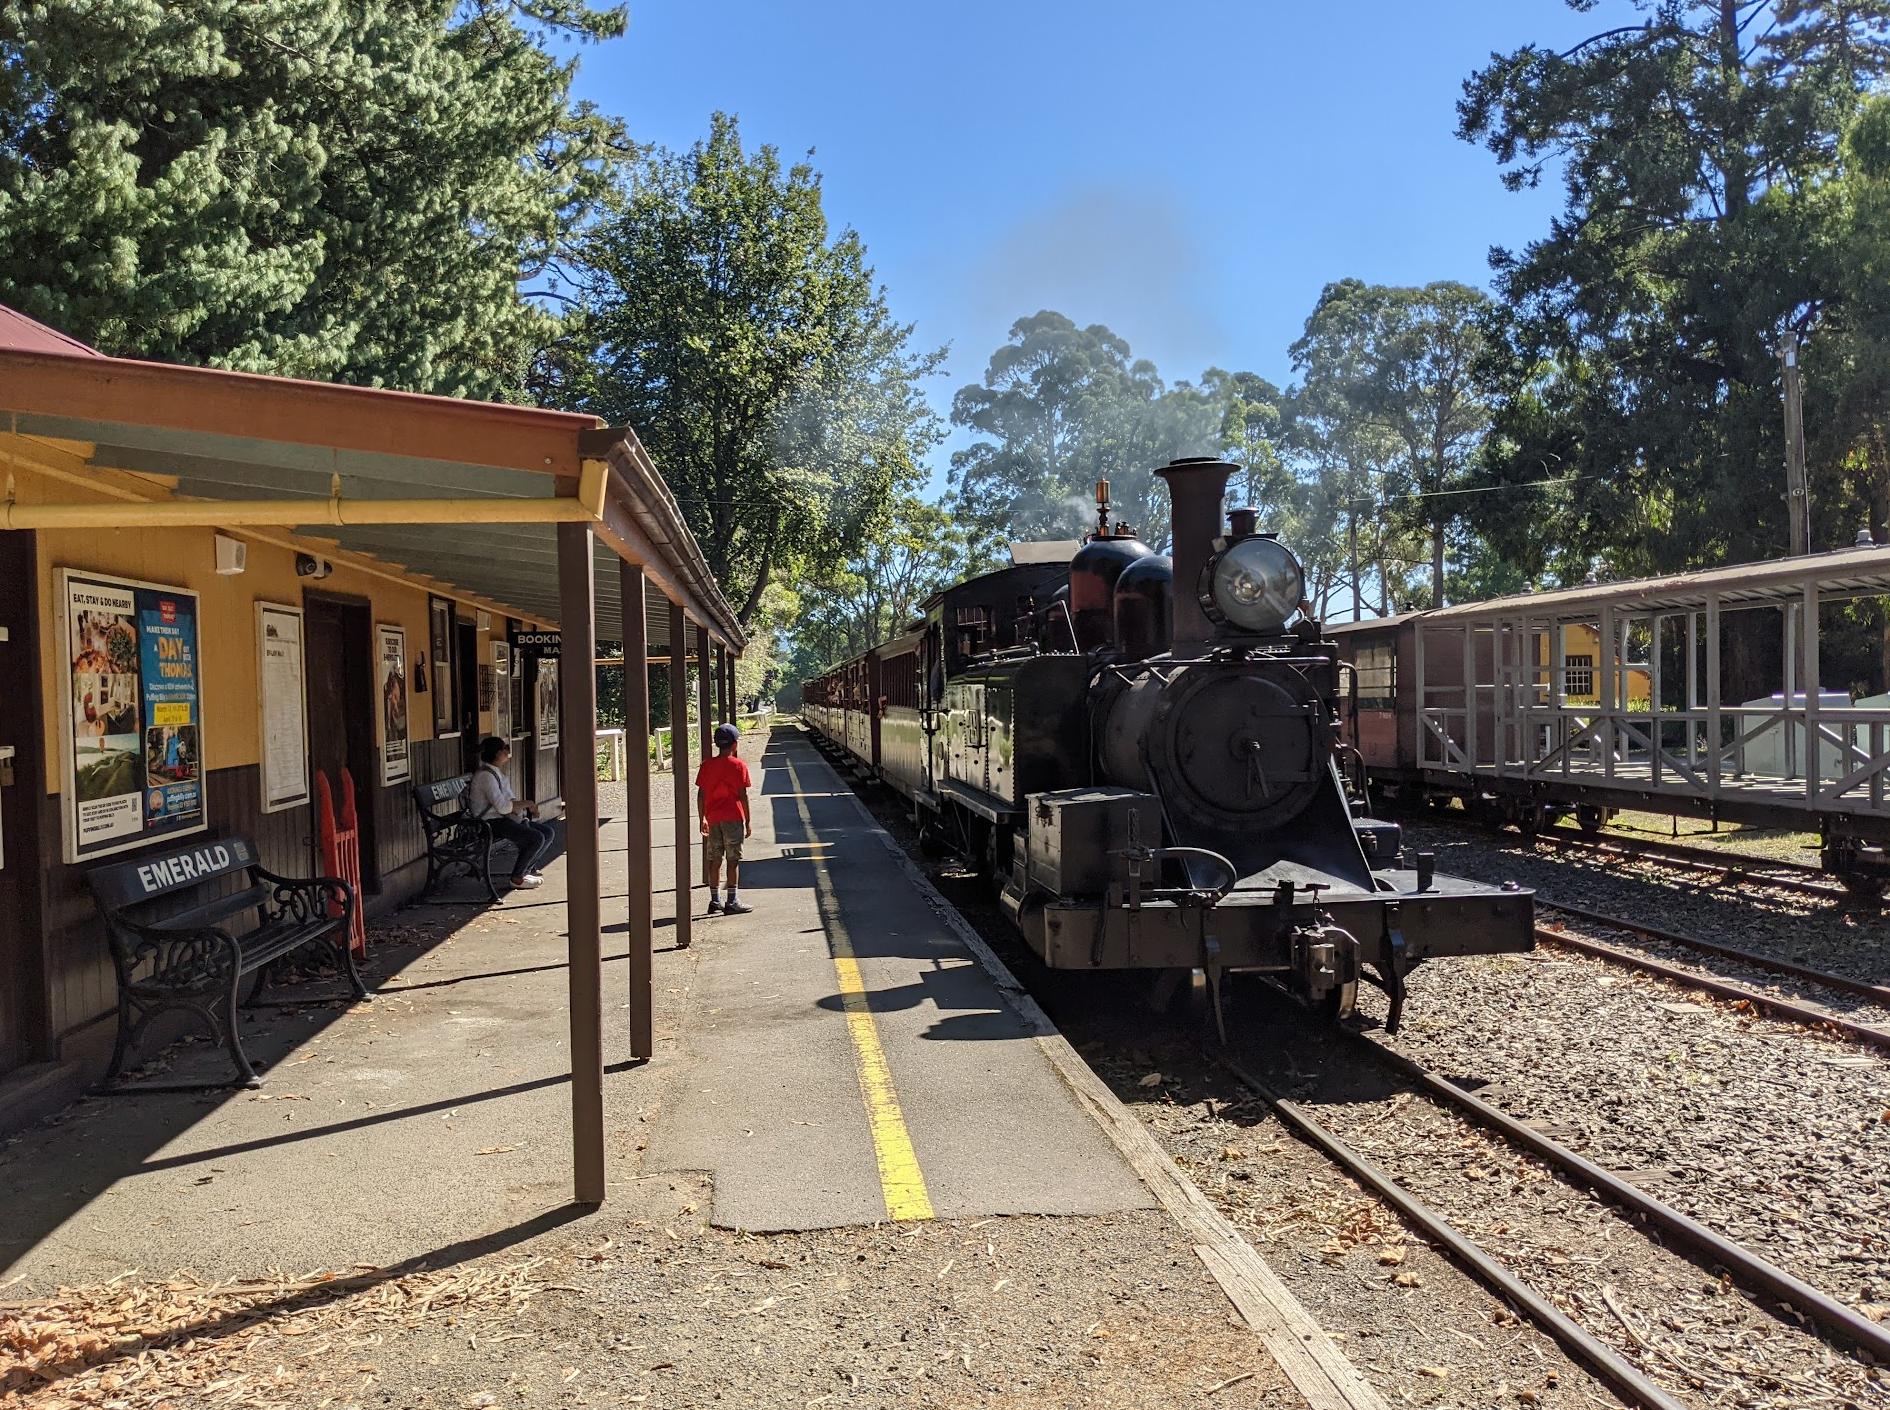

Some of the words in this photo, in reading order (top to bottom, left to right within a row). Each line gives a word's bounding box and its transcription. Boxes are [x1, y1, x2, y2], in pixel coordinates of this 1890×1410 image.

[73, 593, 86, 605] EAT,
[86, 595, 99, 606] STAY
[104, 597, 112, 606] DO
[112, 599, 132, 609] NEARBY
[159, 636, 184, 660] DAY
[159, 662, 192, 678] THOMAS
[137, 845, 230, 892] EMERALD
